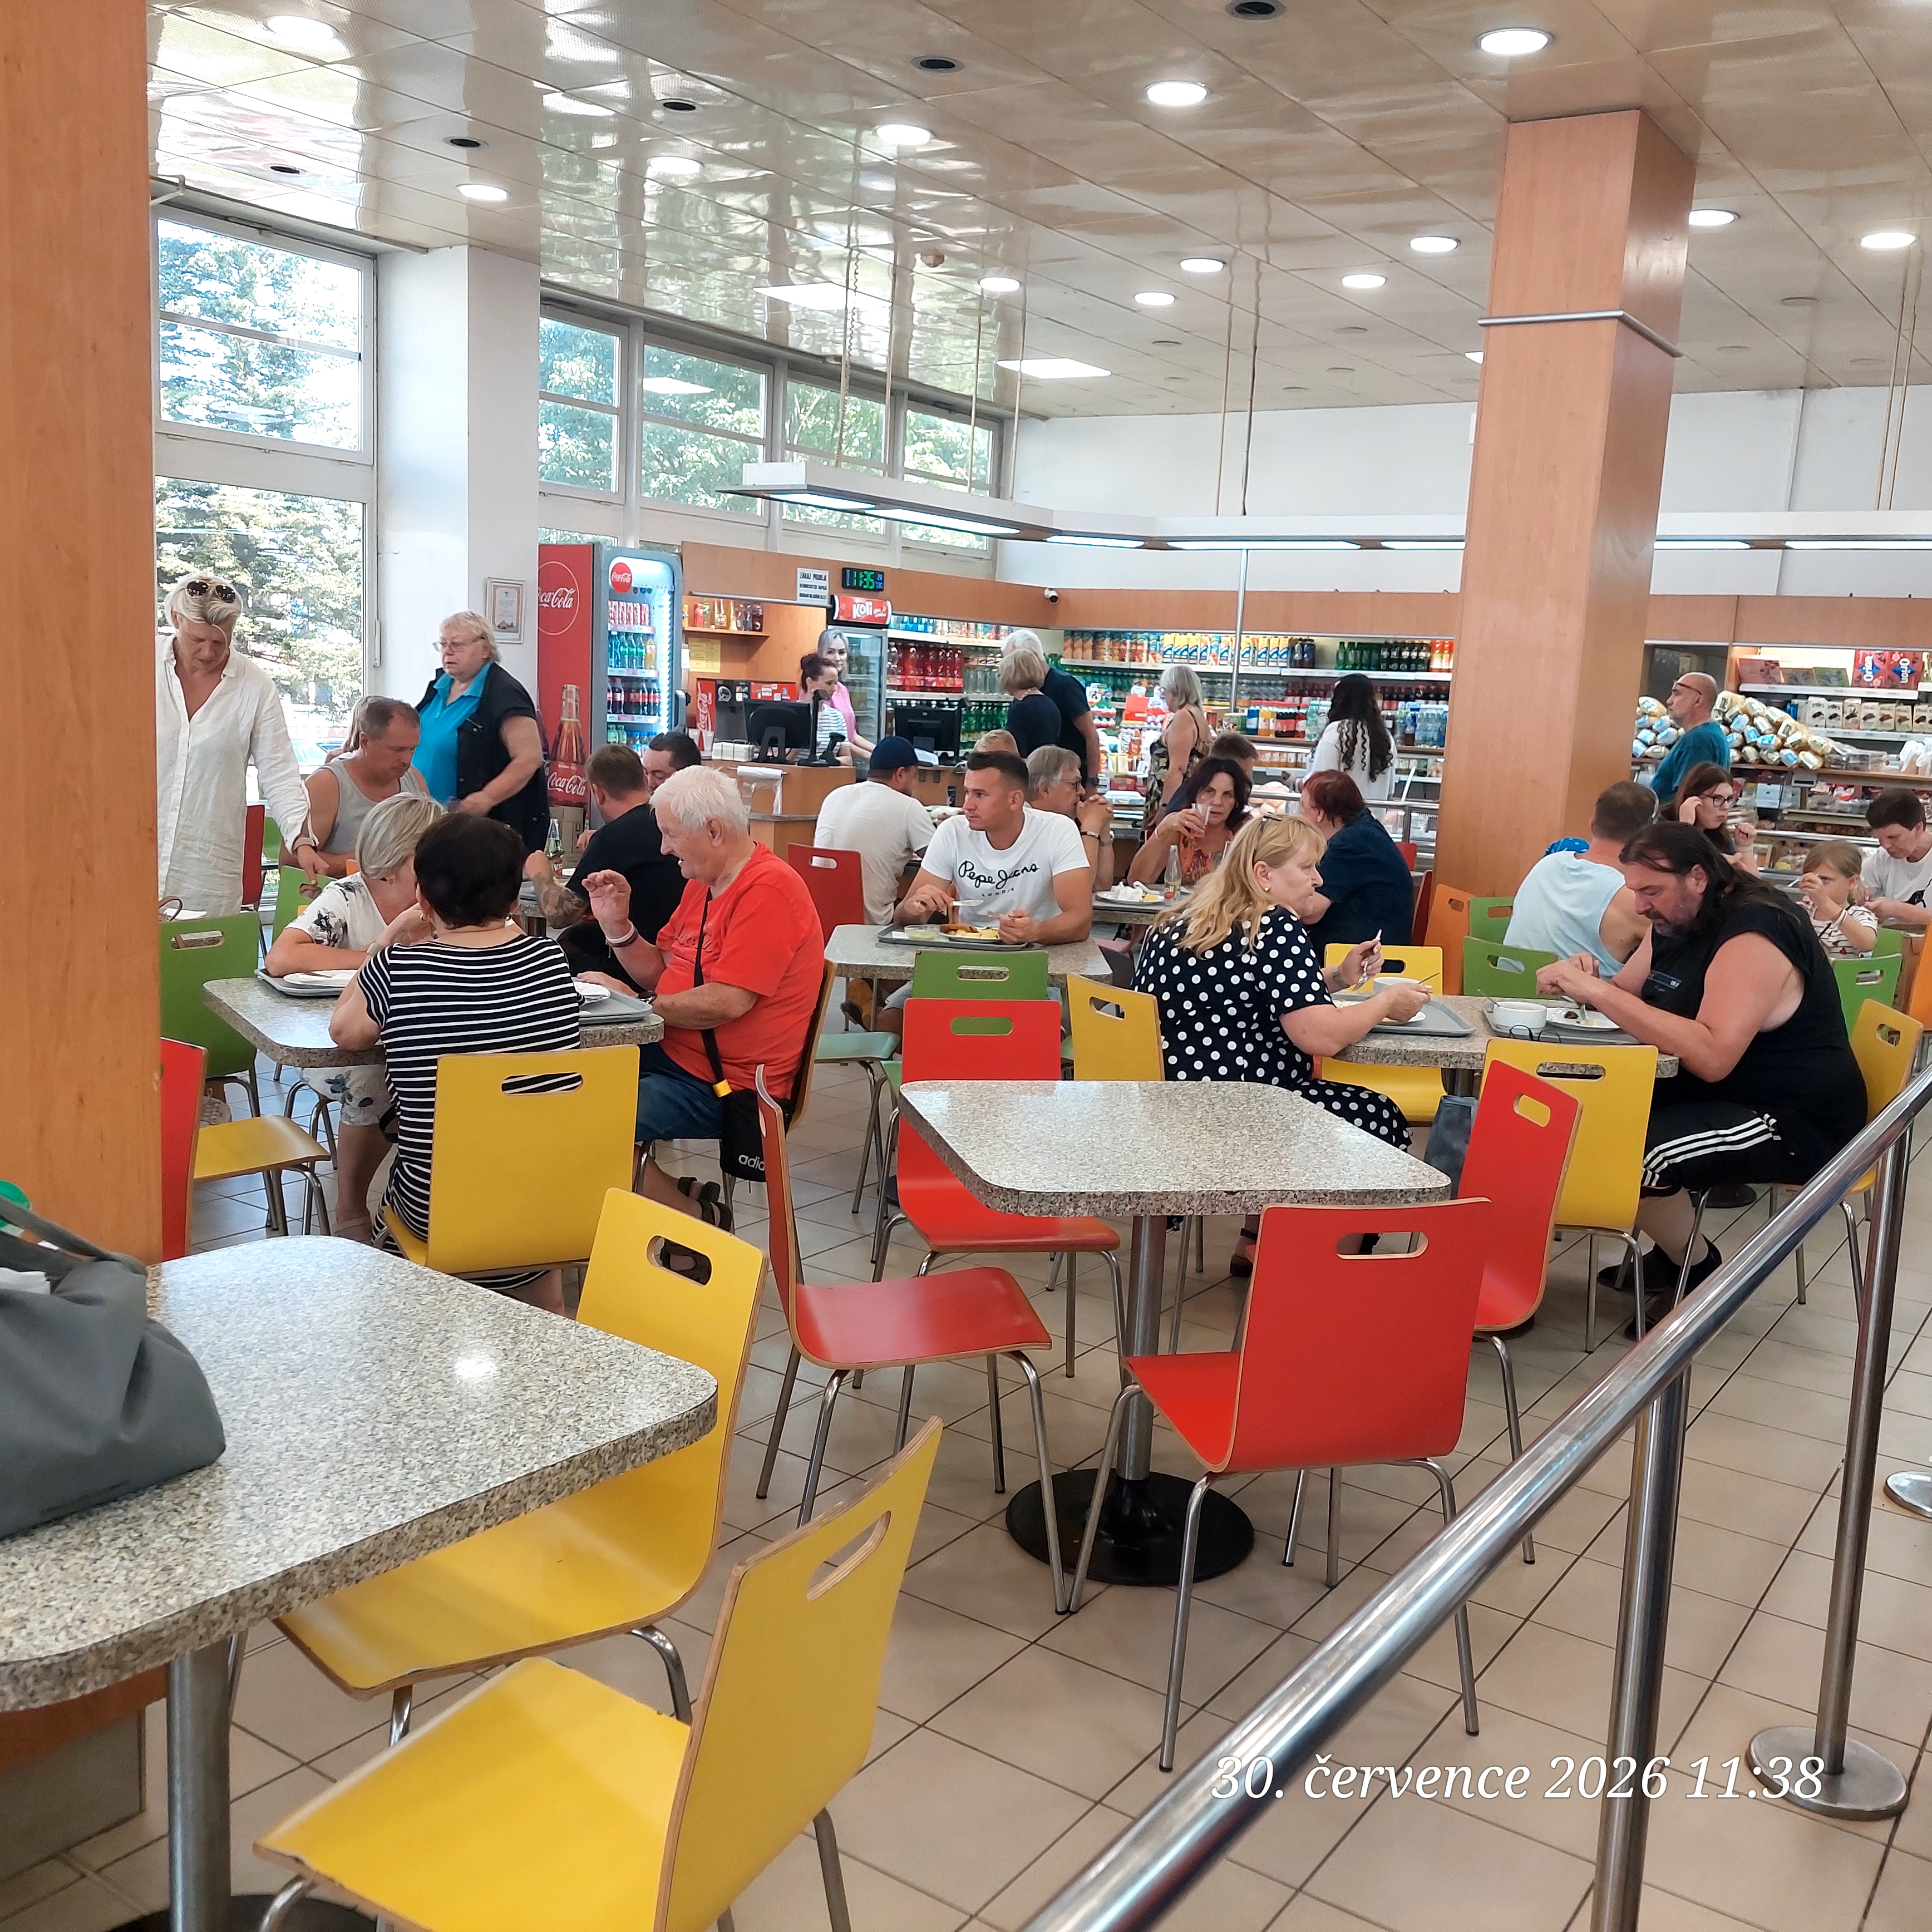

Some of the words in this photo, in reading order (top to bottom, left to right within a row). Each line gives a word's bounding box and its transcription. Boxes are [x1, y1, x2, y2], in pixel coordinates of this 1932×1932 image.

[852, 600, 873, 618] Koli
[1863, 655, 1874, 682] Orion
[1899, 658, 1910, 683] Orion
[958, 860, 995, 888] Pepe
[995, 863, 1039, 889] Jeans
